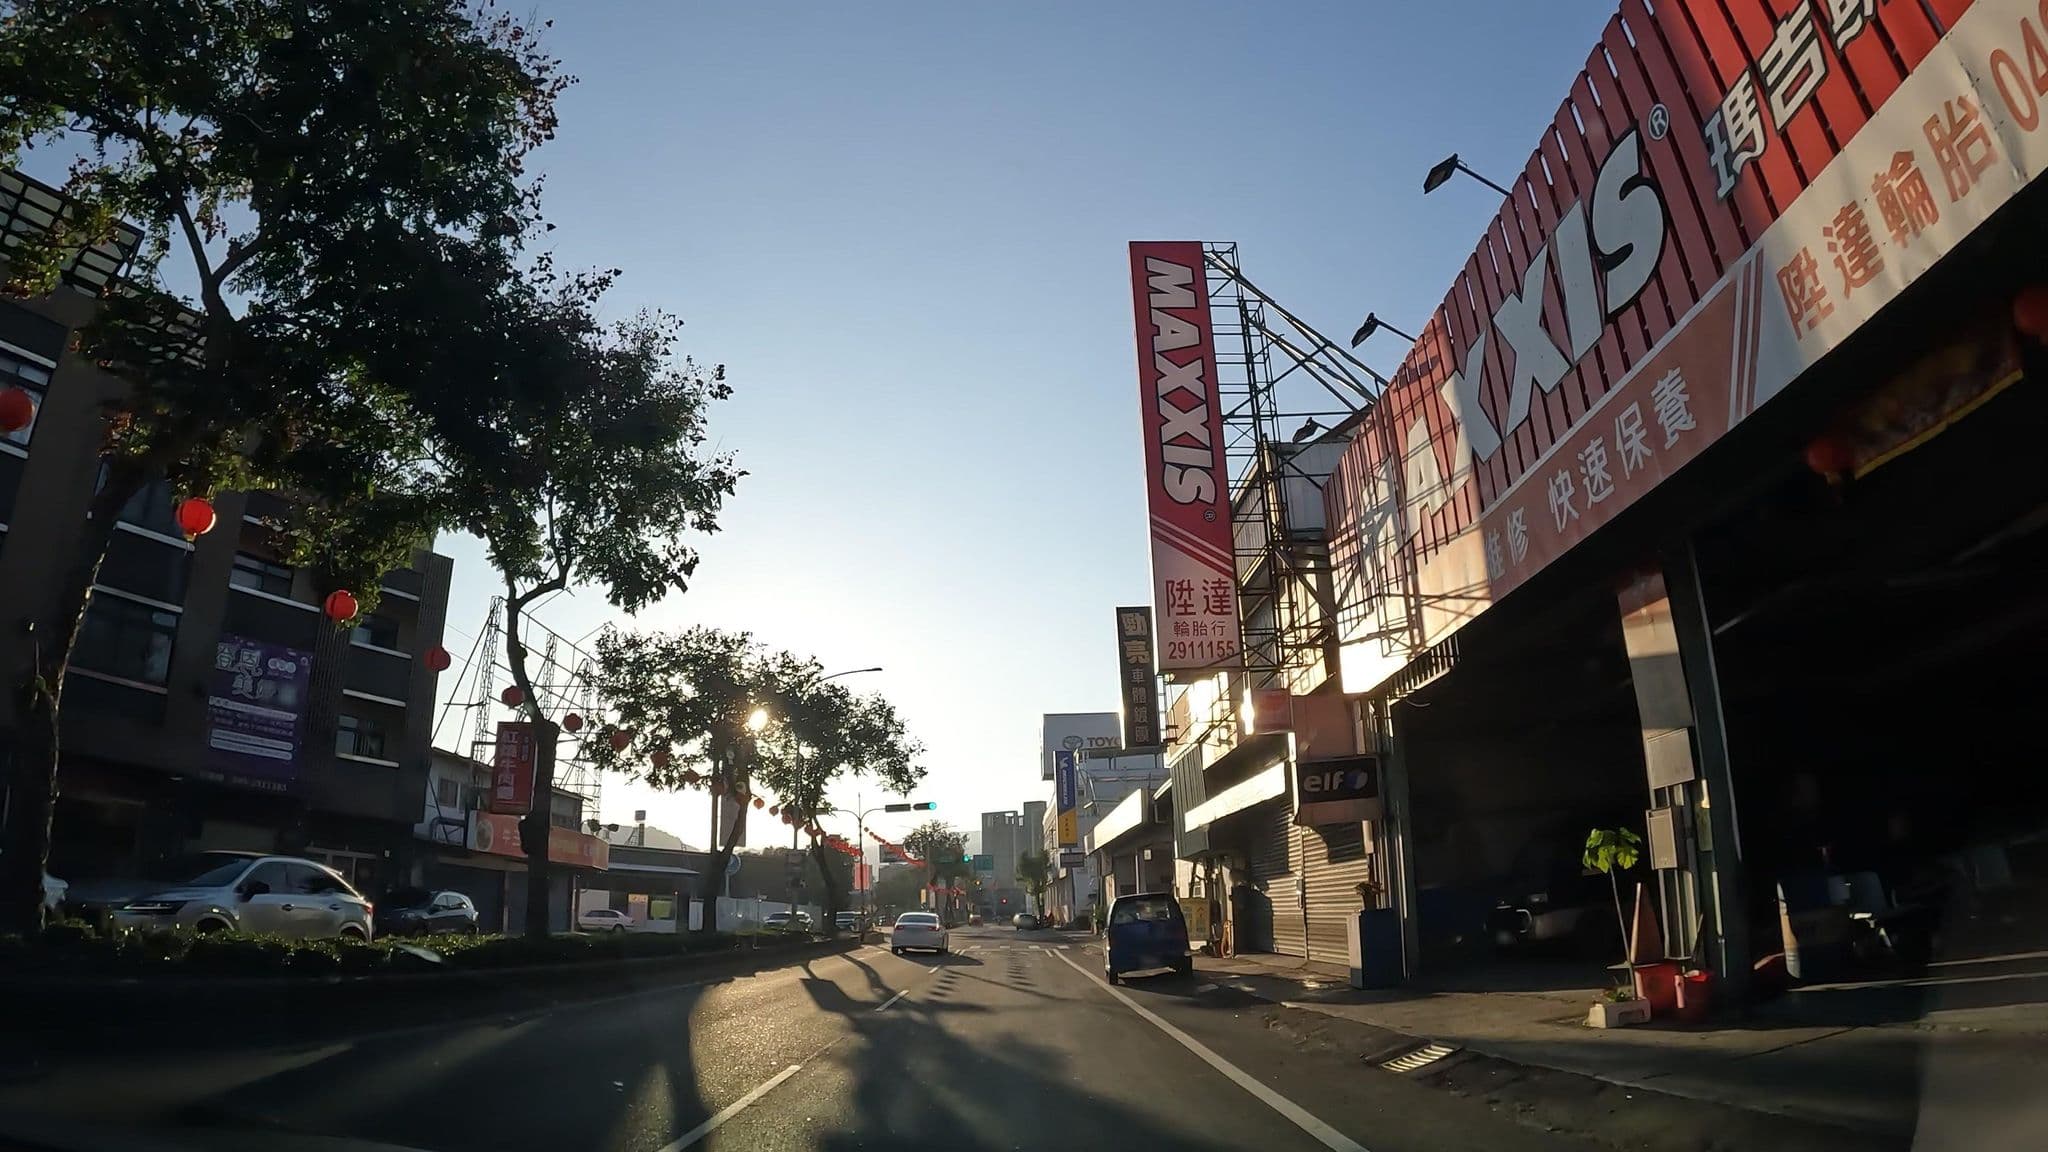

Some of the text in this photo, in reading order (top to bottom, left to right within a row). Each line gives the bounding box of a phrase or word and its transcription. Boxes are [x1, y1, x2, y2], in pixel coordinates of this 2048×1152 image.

[1776, 94, 1999, 341] 陞達輪胎
[1145, 254, 1217, 506] MAXXIS
[1358, 128, 1668, 587] MAXXIS
[1547, 366, 1698, 534] 快速保養
[1166, 577, 1233, 617] 陞達
[1173, 620, 1226, 638] 輪胎行
[1168, 640, 1236, 660] 2911155
[1303, 770, 1346, 793] elf
